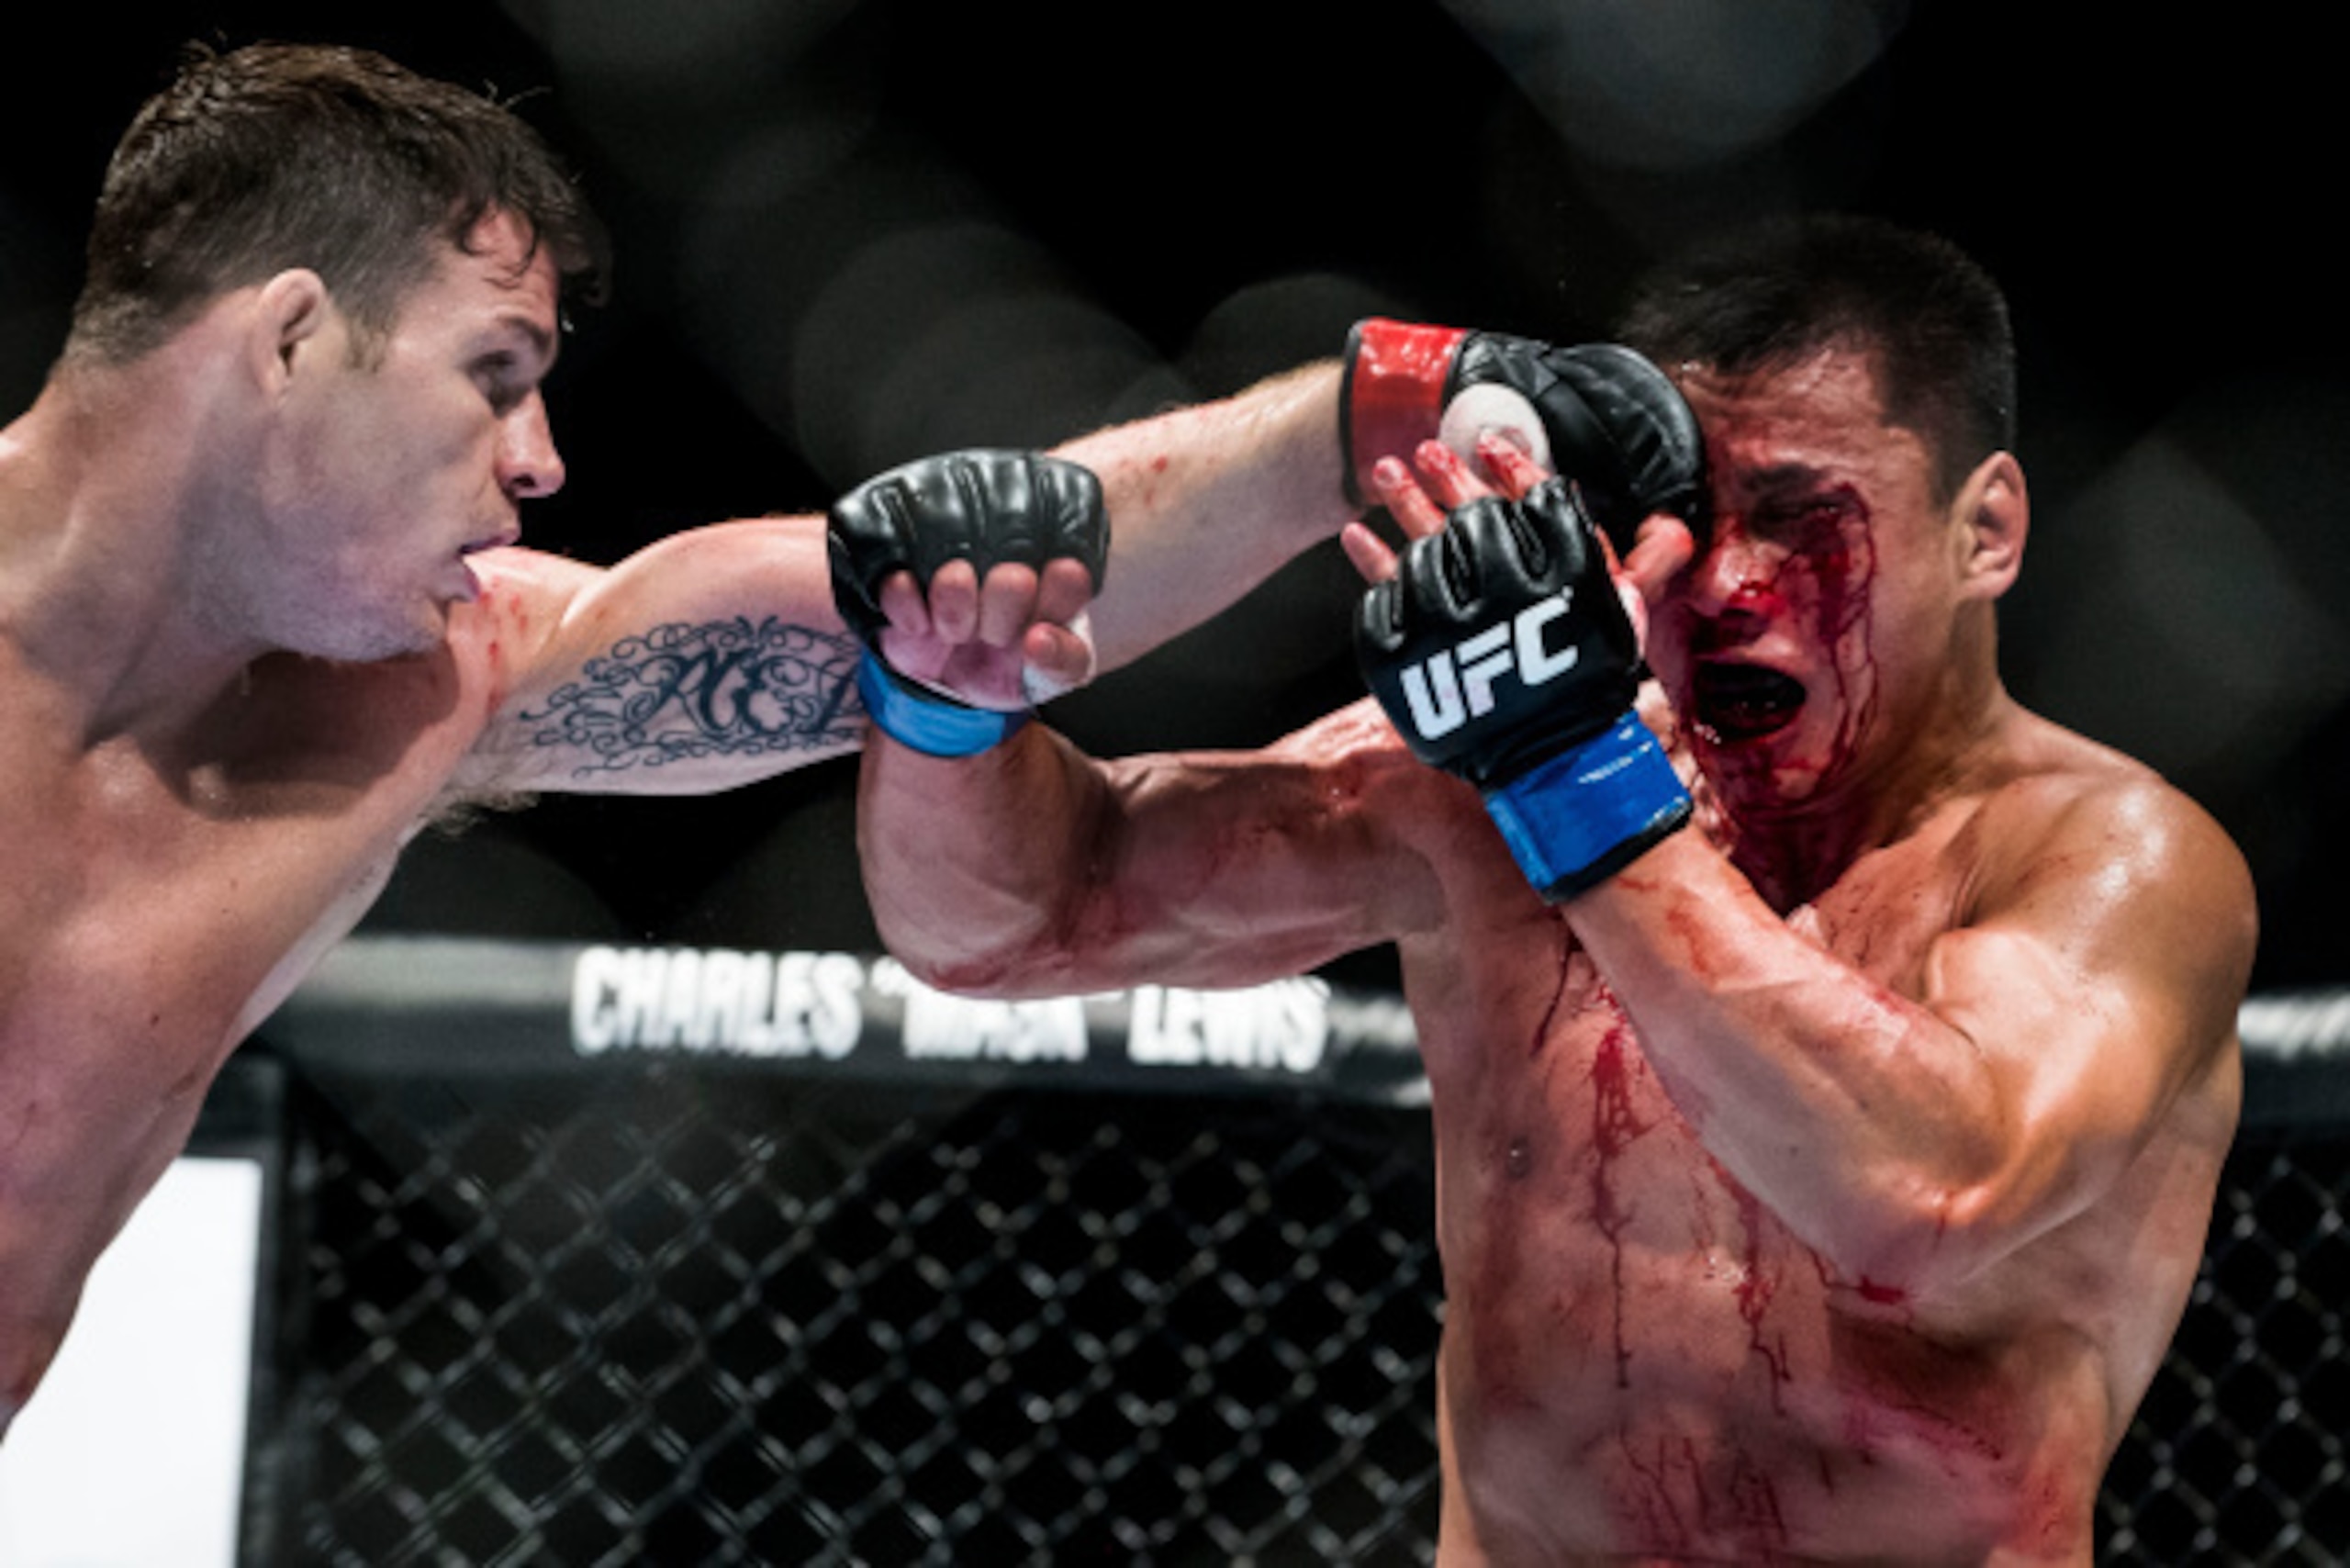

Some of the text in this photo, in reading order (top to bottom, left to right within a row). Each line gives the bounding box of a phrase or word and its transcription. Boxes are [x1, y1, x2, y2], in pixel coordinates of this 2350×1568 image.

[1399, 594, 1578, 741] UFC
[573, 946, 863, 1060] CHARLES
[1128, 975, 1330, 1072] LEWIS
